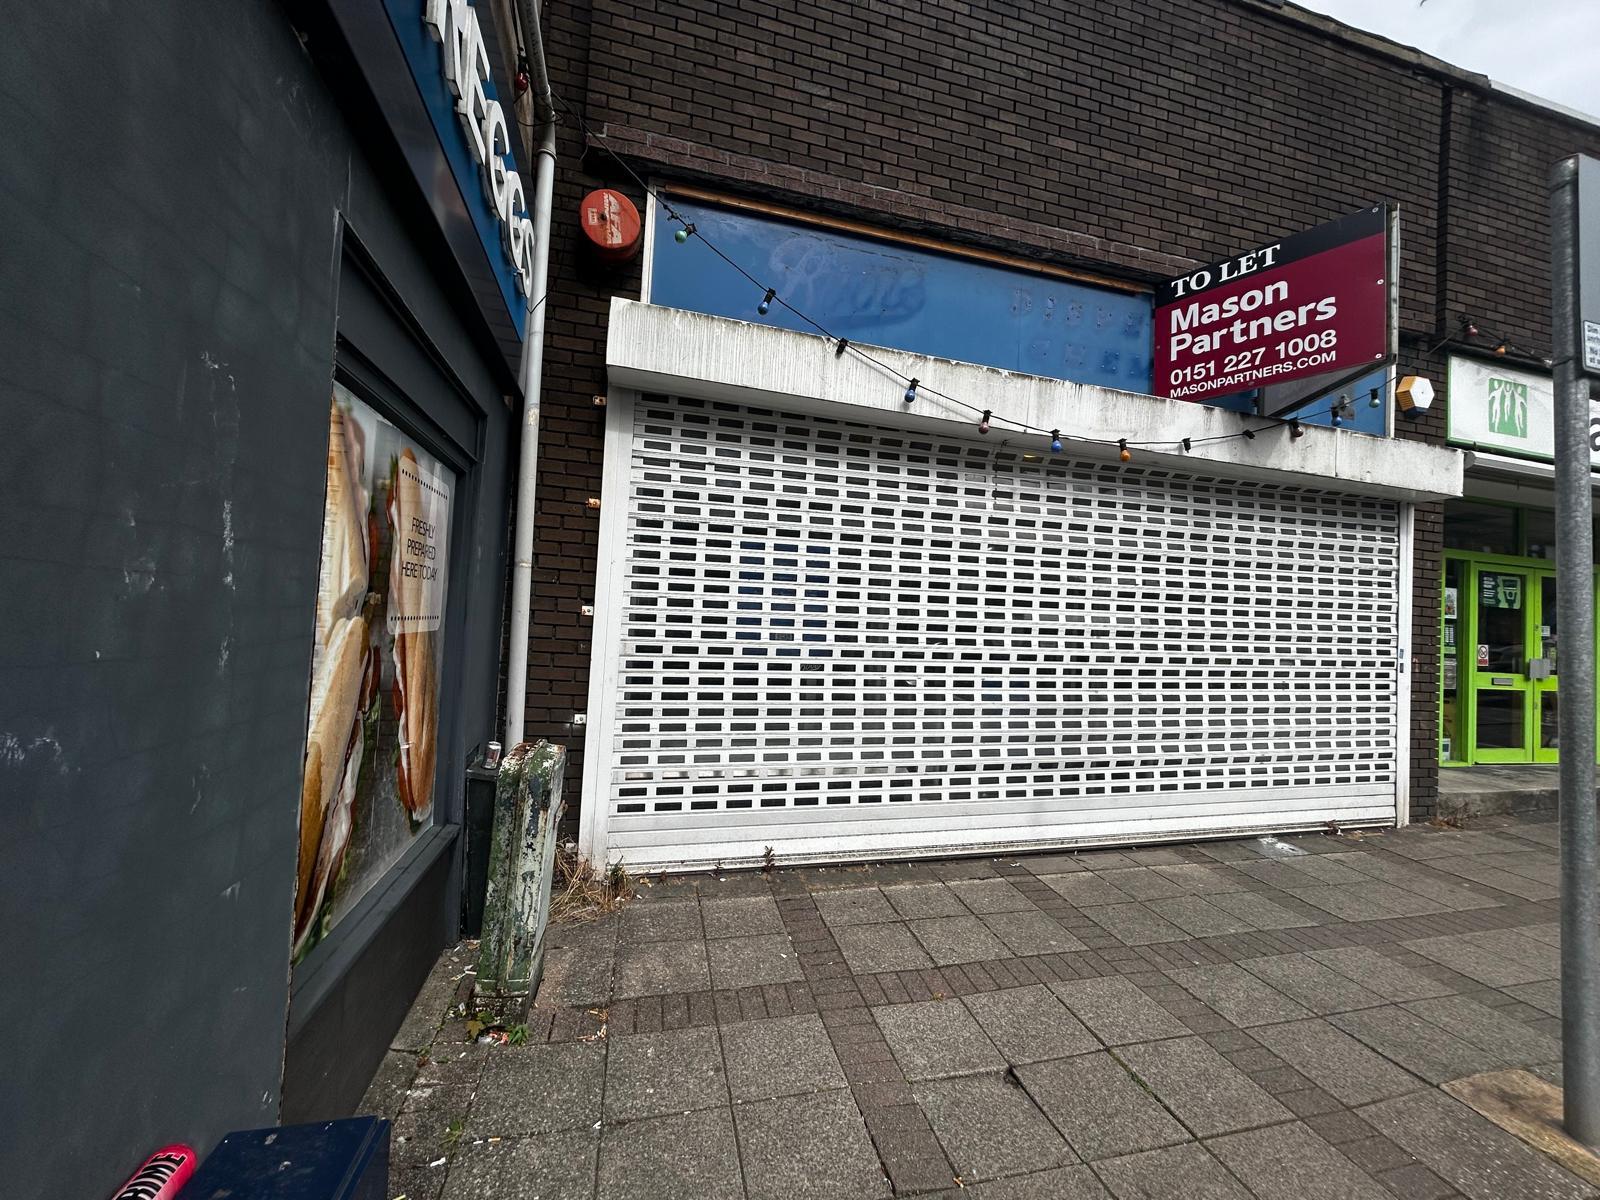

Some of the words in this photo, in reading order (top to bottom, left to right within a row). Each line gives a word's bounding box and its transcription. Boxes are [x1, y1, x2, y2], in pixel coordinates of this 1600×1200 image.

[1170, 270, 1211, 298] TO
[1218, 244, 1281, 282] LET
[1170, 280, 1289, 334] Mason
[1170, 296, 1337, 361] Partners
[1170, 360, 1215, 385] 0151
[1223, 347, 1266, 373] 227
[1275, 329, 1337, 359] 1008
[1170, 350, 1336, 398] MASONPARTNERS.COM
[406, 538, 436, 560] PREPARED
[412, 517, 435, 538] FRESHLY
[400, 561, 418, 578] HERE
[418, 564, 438, 581] TODAY
